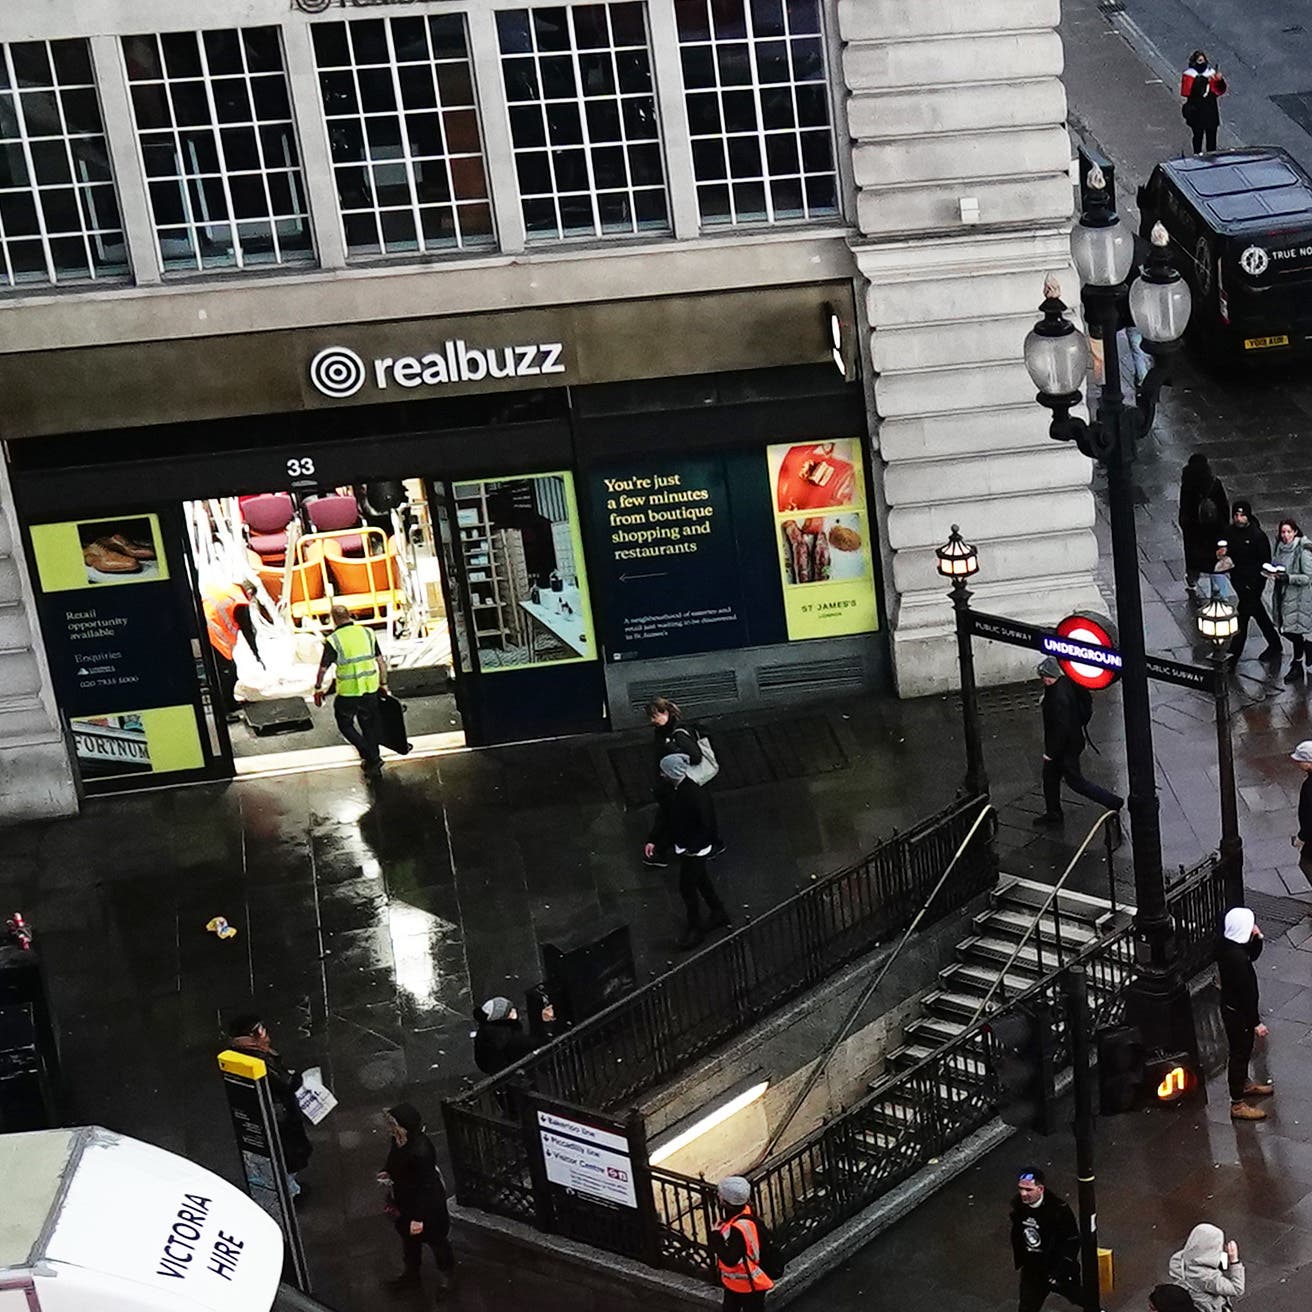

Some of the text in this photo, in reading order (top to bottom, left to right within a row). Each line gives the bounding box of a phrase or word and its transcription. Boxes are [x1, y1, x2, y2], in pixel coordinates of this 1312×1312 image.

[1272, 248, 1296, 260] TRUE
[374, 339, 566, 389] realbuzz
[286, 457, 315, 476] 33
[604, 474, 681, 493] You're just
[607, 489, 709, 510] a few minutes
[609, 506, 713, 527] from boutique
[612, 521, 712, 544] shopping and
[614, 541, 697, 560] restaurants
[65, 608, 97, 621] Retail
[67, 616, 129, 631] opportunity
[69, 627, 115, 641] available
[975, 621, 1032, 642] PUBLIC SUBWAY
[1171, 668, 1204, 682] SUBWAY
[551, 1136, 600, 1158] Piccadilly line
[579, 1159, 605, 1174] Centre
[156, 1193, 213, 1279] VICTORIA
[206, 1230, 244, 1281] HIRE
